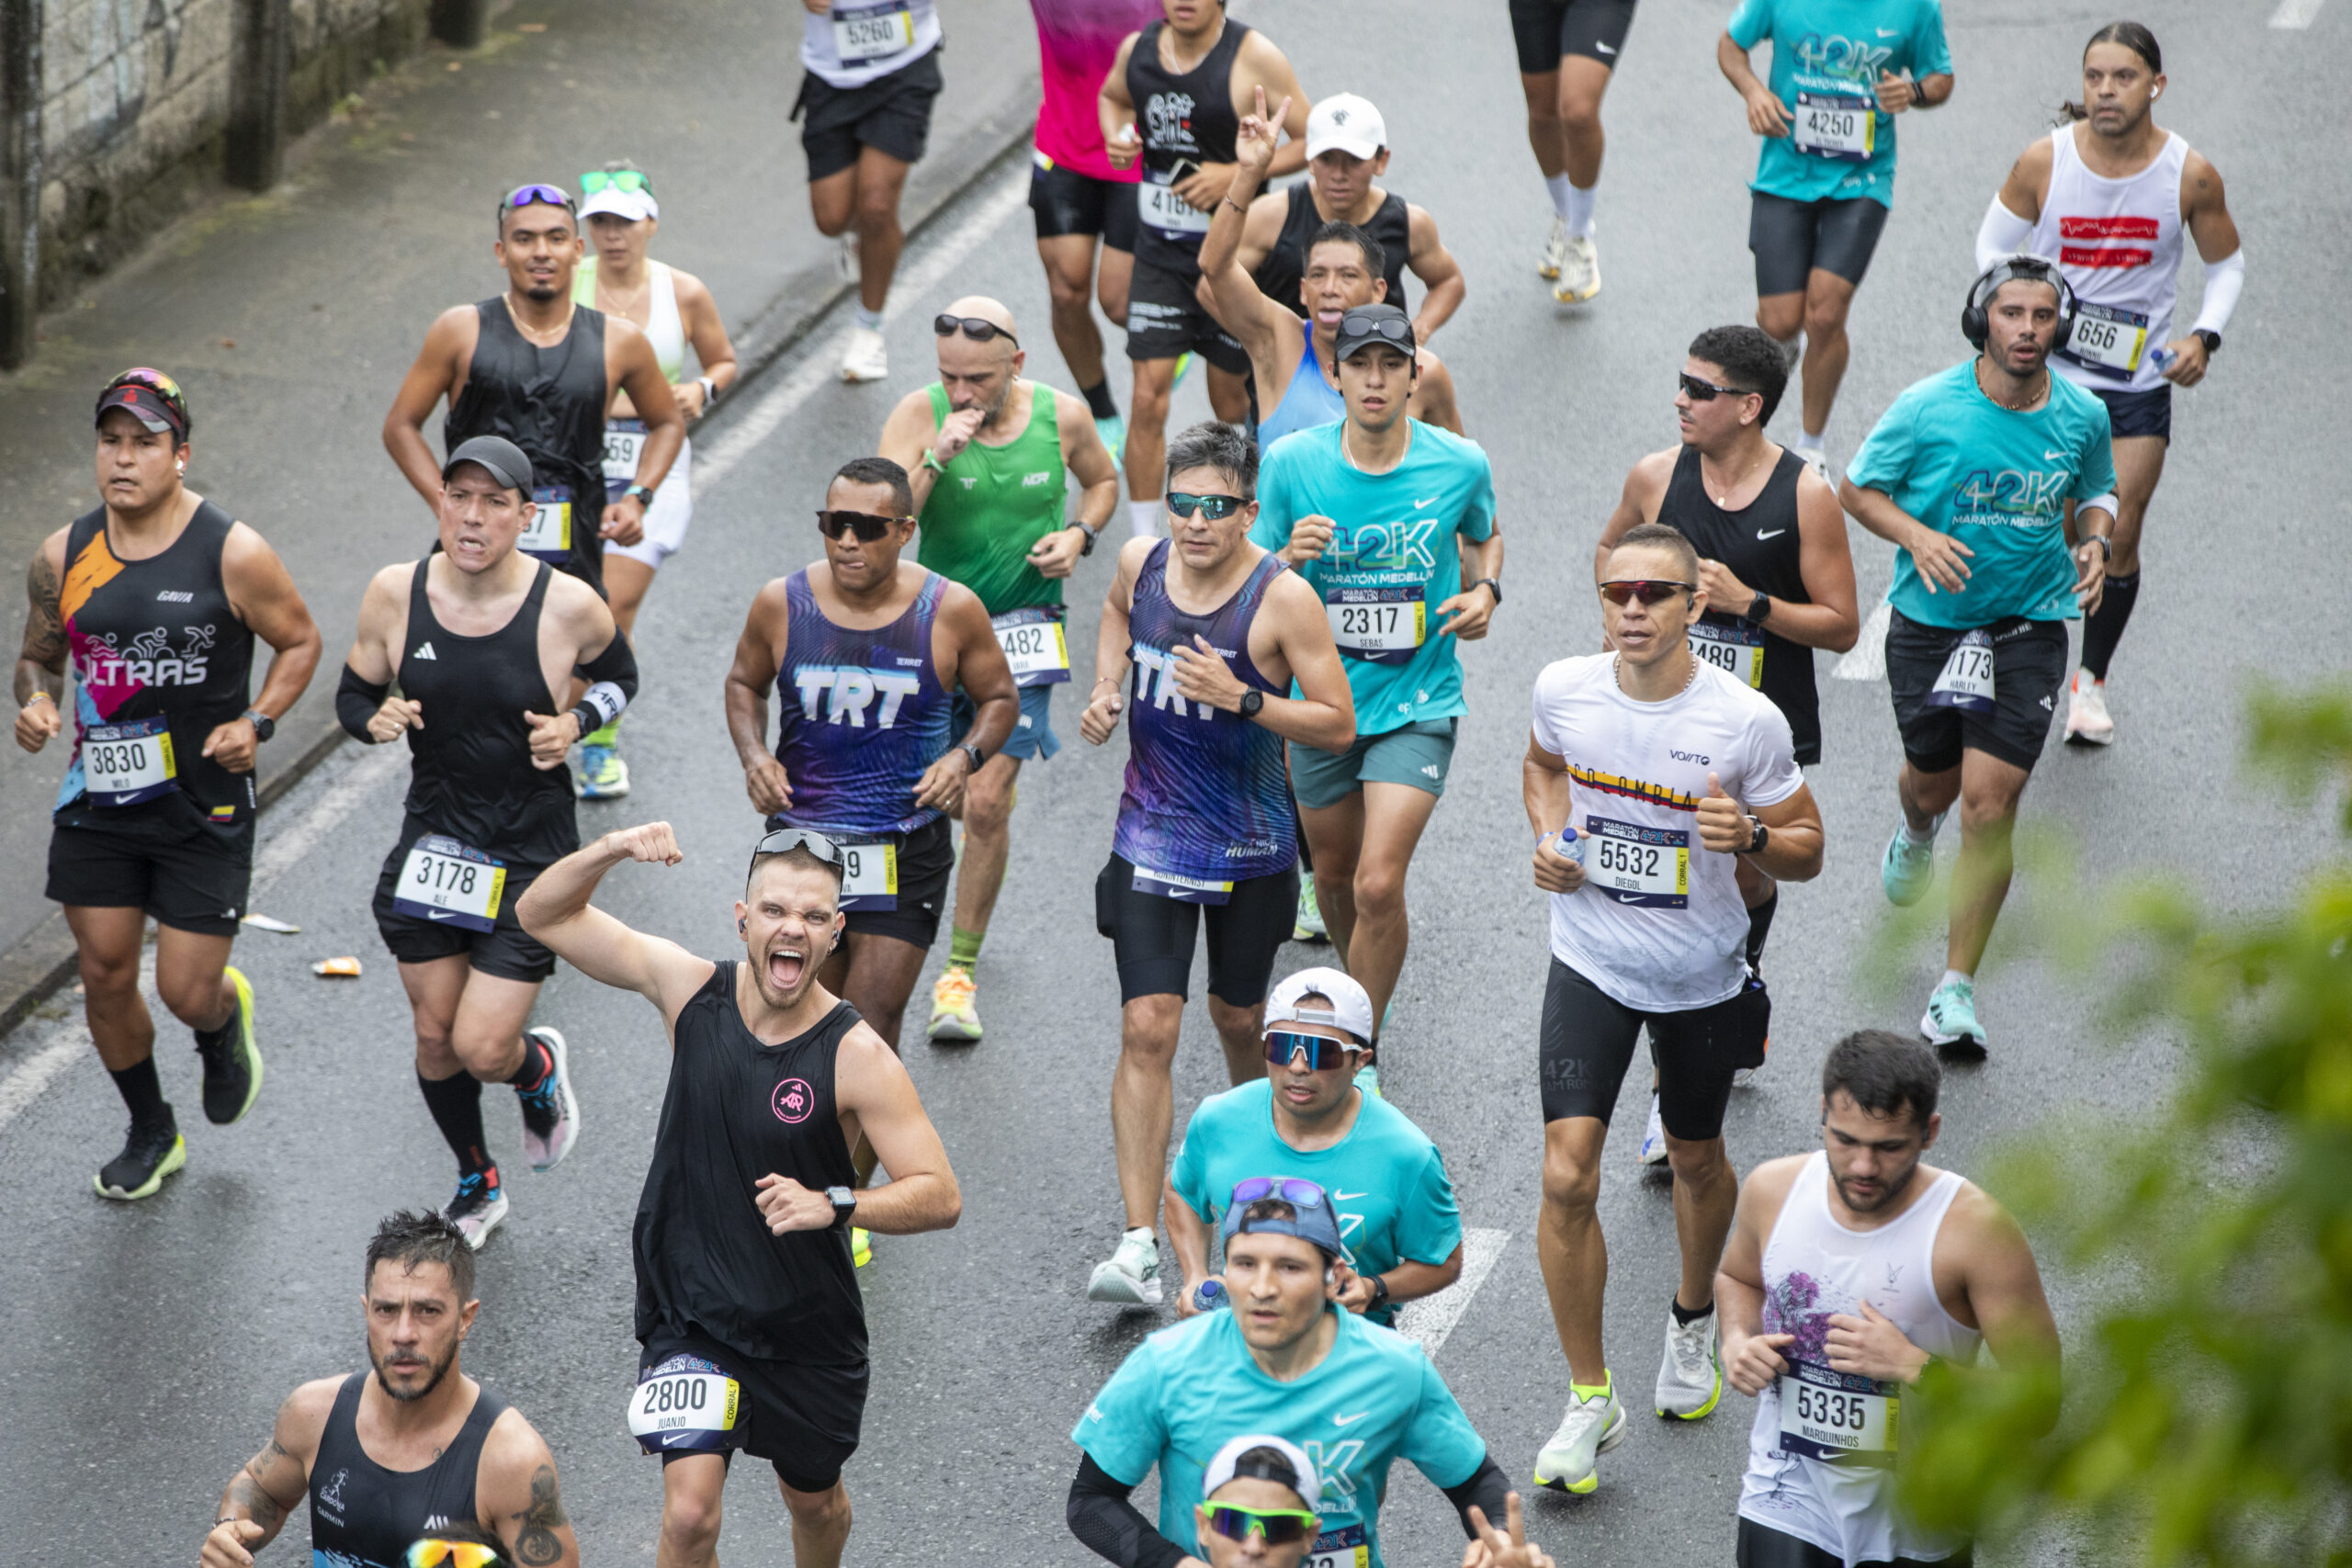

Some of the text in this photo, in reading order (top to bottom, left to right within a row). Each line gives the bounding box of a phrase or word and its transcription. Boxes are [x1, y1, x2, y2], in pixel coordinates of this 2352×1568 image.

[847, 18, 895, 45] 5260
[1807, 111, 1854, 137] 4250
[2077, 320, 2118, 350] 656
[1954, 468, 2070, 517] 42K
[1342, 607, 1398, 634] 2317
[995, 628, 1045, 657] 482
[1360, 638, 1384, 649] SEBAS
[1688, 639, 1736, 672] 489
[1134, 639, 1215, 721] TR
[1949, 679, 1977, 694] HARLEY
[794, 664, 921, 729] TRT
[92, 743, 147, 774] 3830
[1574, 763, 1692, 812] COLOMBIA
[1225, 843, 1279, 858] HUMAN
[1640, 830, 1670, 844] 42K
[1600, 840, 1659, 877] 5532
[416, 856, 477, 895] 3178
[1615, 876, 1642, 891] DIEGOL
[1679, 860, 1688, 886] CORRAL
[434, 894, 448, 906] ALE
[687, 1358, 721, 1373] 42K
[643, 1378, 707, 1416] 2800
[726, 1389, 738, 1420] CORRAL
[1798, 1385, 1866, 1431] 5335
[657, 1416, 686, 1430] JUANJO
[1802, 1425, 1860, 1449] MARQUINHOS
[317, 1505, 345, 1528] GARMIN
